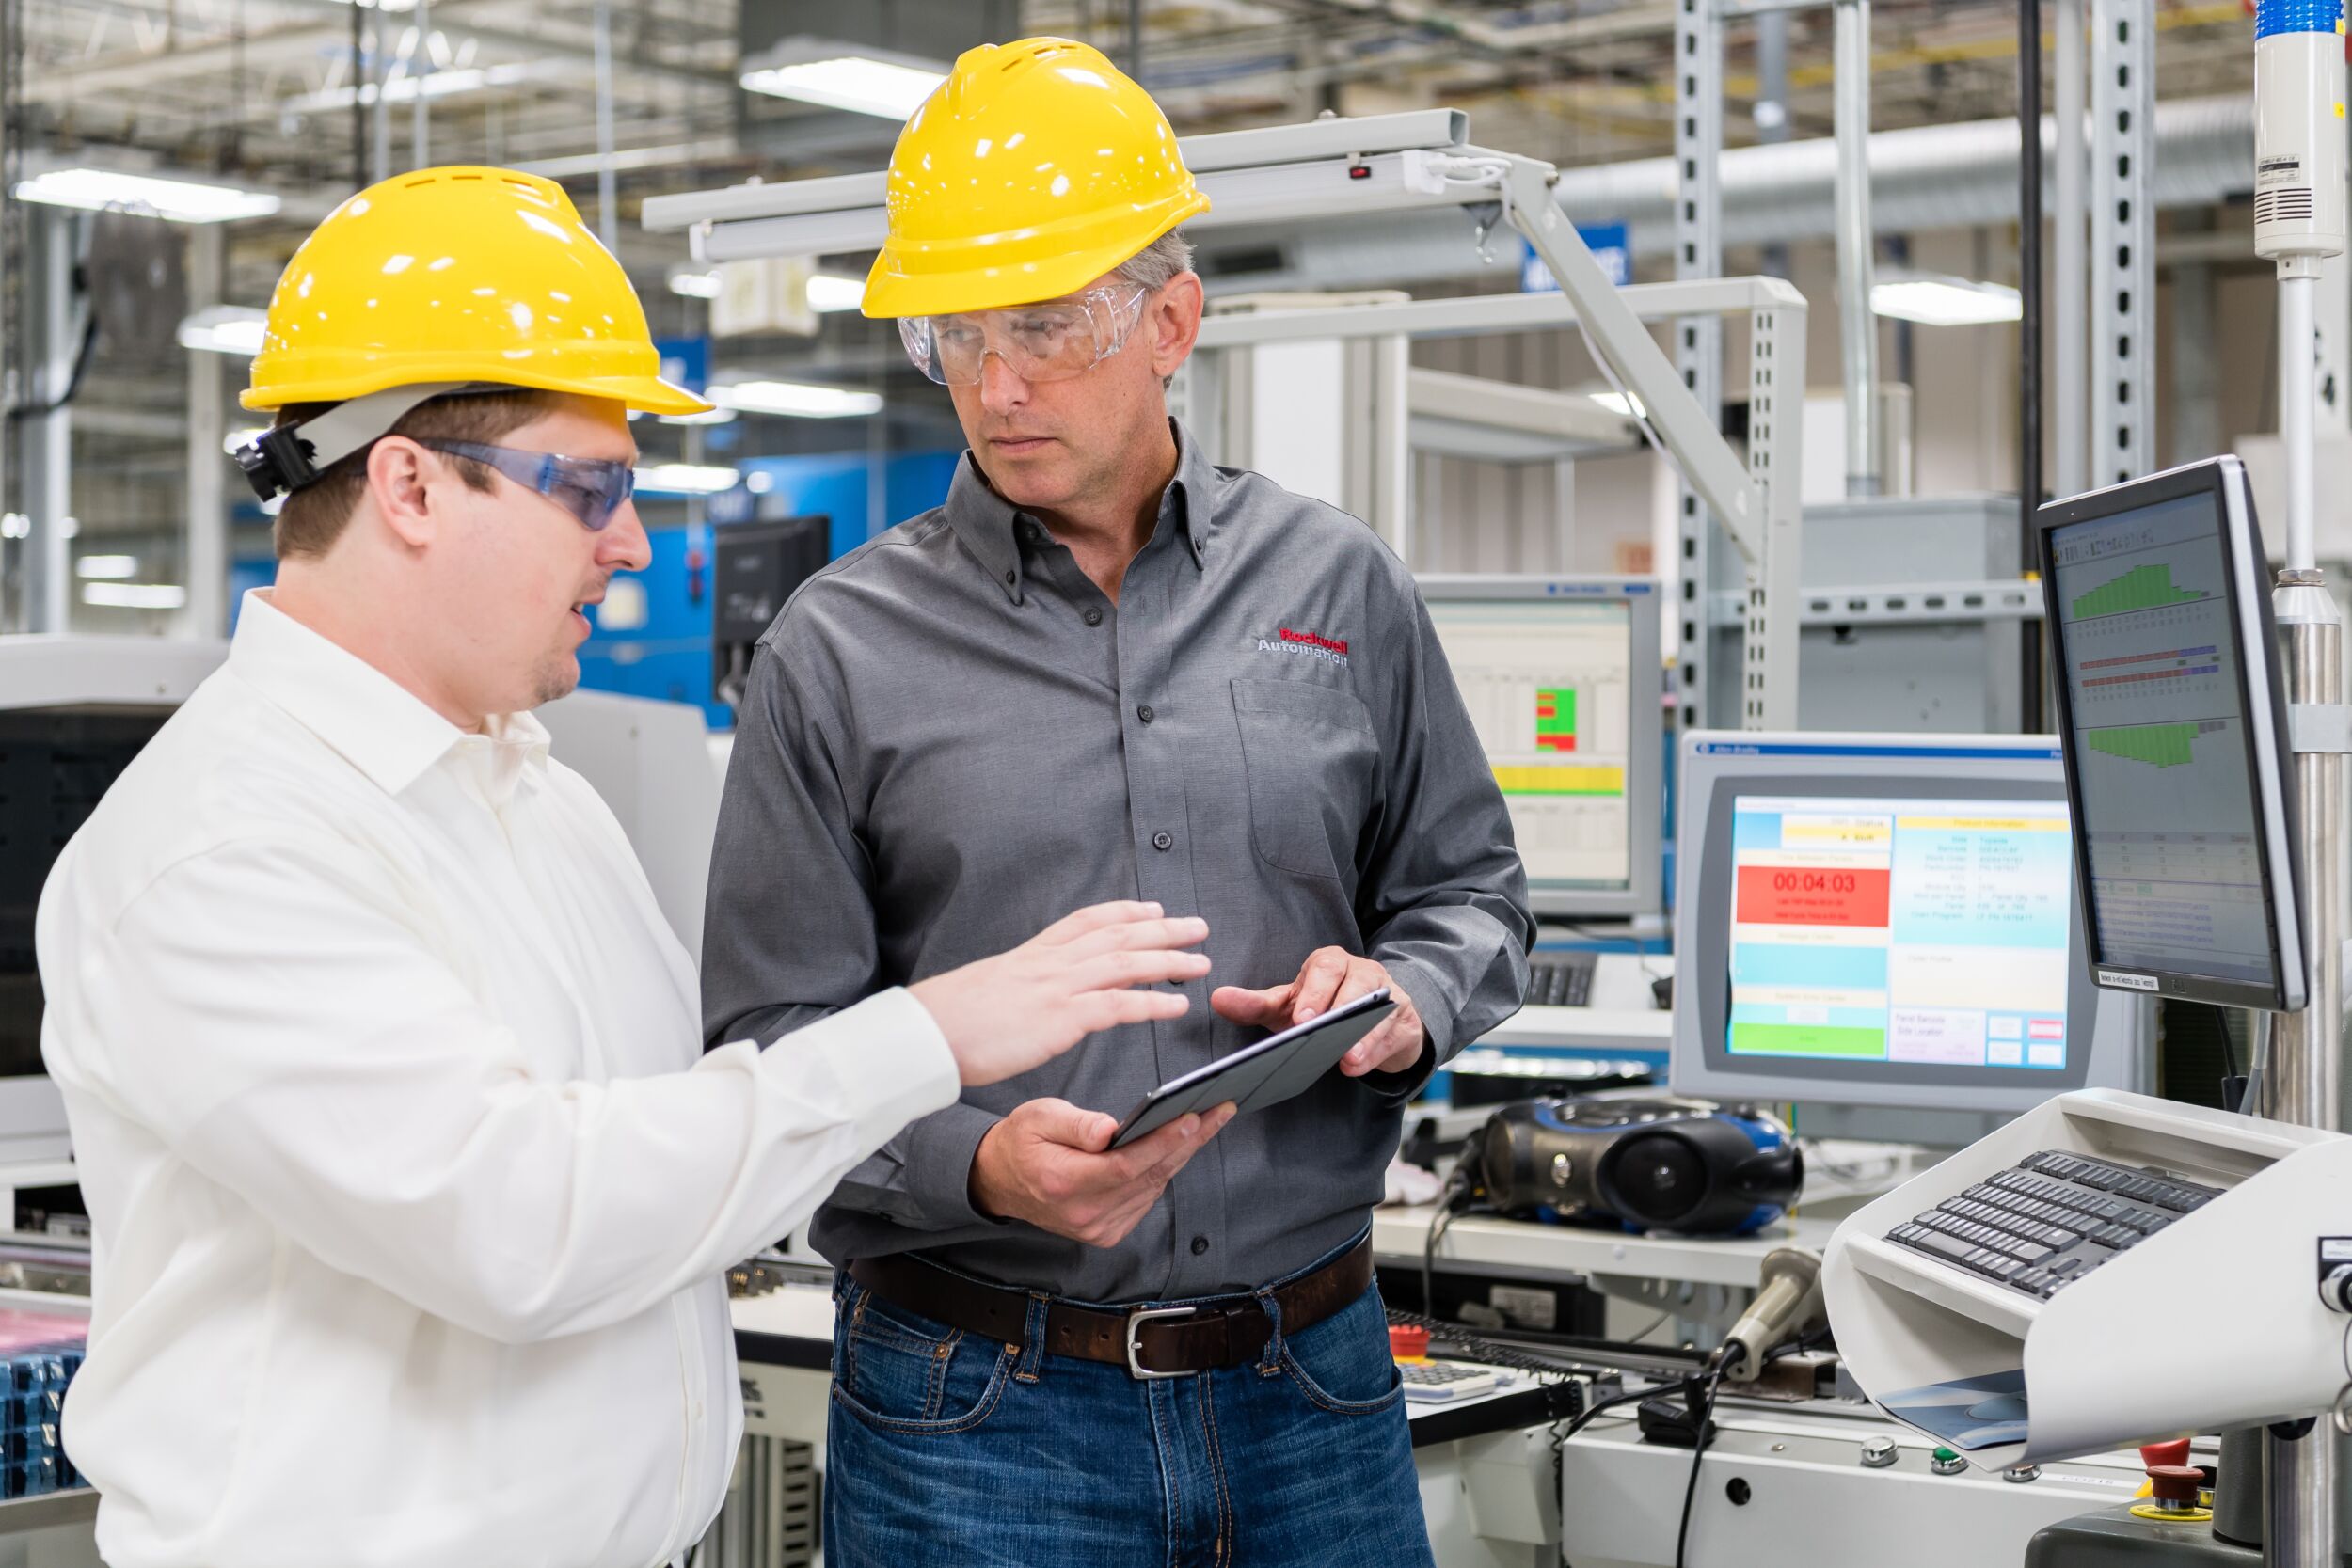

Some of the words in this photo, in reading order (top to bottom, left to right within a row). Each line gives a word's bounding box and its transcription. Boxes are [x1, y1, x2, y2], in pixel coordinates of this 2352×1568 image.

[1258, 639, 1348, 667] Automation
[1279, 627, 1348, 655] Rockwell
[1774, 872, 1856, 893] 00:04:03
